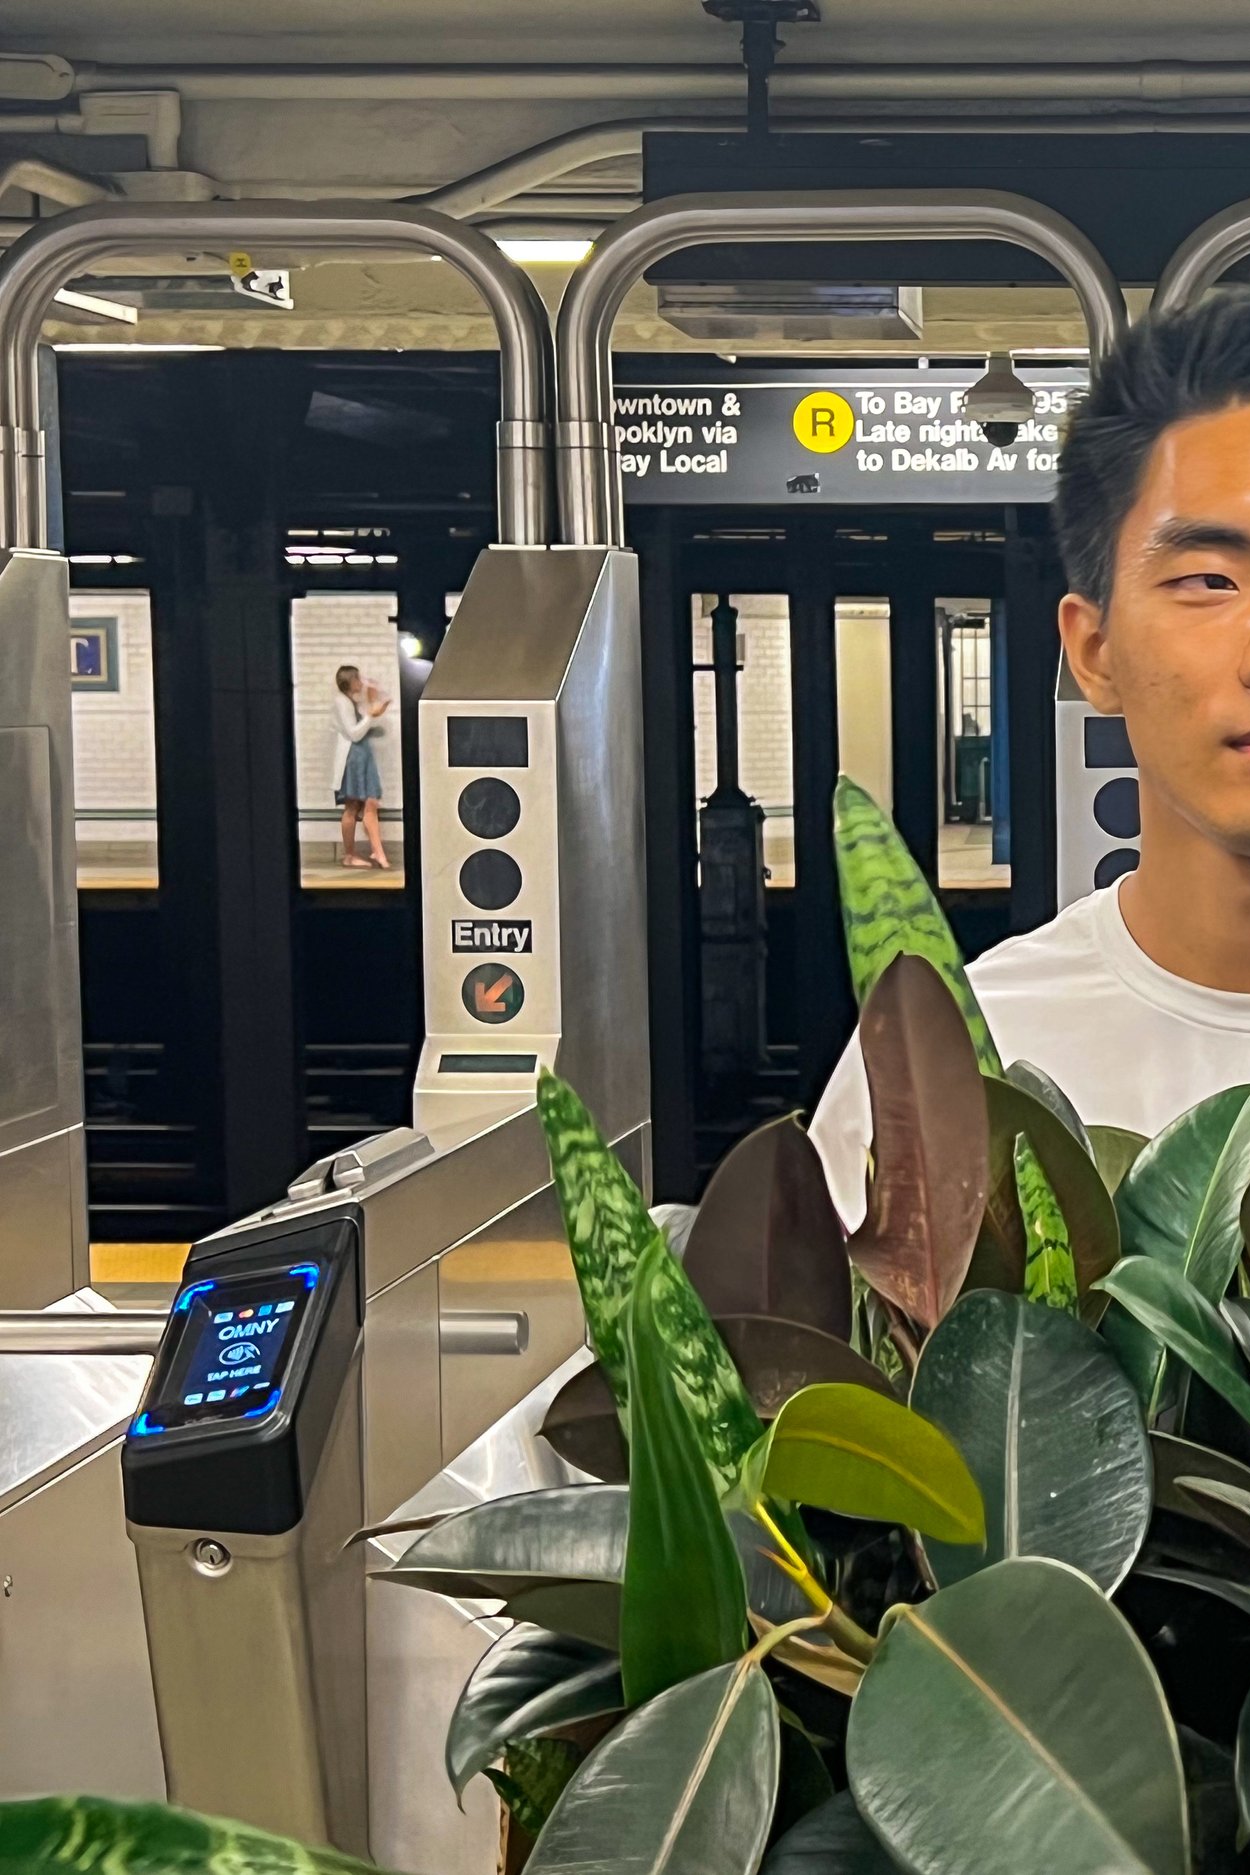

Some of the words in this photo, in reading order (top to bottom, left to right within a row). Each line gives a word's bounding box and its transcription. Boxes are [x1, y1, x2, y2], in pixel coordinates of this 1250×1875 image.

[612, 394, 712, 416] wntown
[721, 392, 741, 417] &
[855, 391, 886, 415] To
[894, 391, 942, 418] Bay
[701, 421, 738, 444] via
[811, 408, 835, 437] R
[855, 420, 911, 443] Late
[1015, 419, 1059, 443] ake
[660, 450, 728, 473] Local
[856, 449, 884, 472] to
[891, 449, 979, 472] Dekalb
[986, 447, 1018, 472] Av
[455, 922, 529, 952] Entry
[218, 1318, 279, 1340] OMNY
[229, 1365, 262, 1378] HERE
